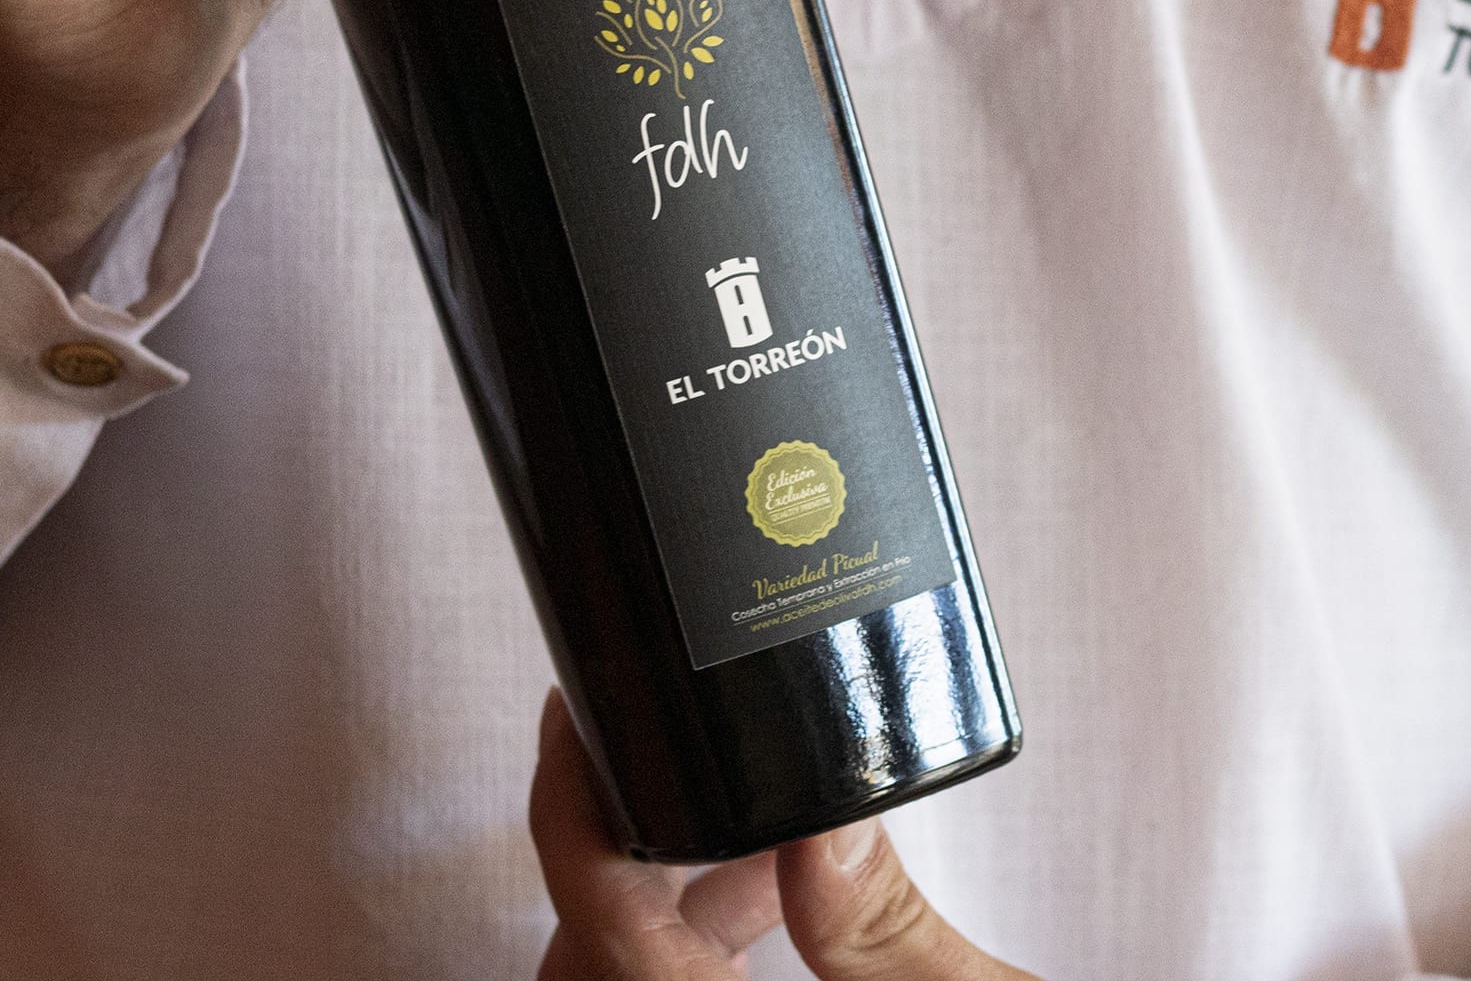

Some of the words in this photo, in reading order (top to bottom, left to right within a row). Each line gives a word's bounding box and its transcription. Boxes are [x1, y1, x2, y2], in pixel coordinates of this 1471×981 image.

[632, 99, 748, 220] fdh
[666, 375, 706, 405] EL
[706, 326, 847, 390] TORREÓN
[764, 482, 828, 510] Exclusiva
[766, 466, 816, 492] Edición
[731, 602, 777, 621] Cosecha
[776, 585, 826, 608] Temprana
[881, 561, 895, 572] en
[752, 558, 828, 600] Variedad
[832, 540, 879, 575] Picual
